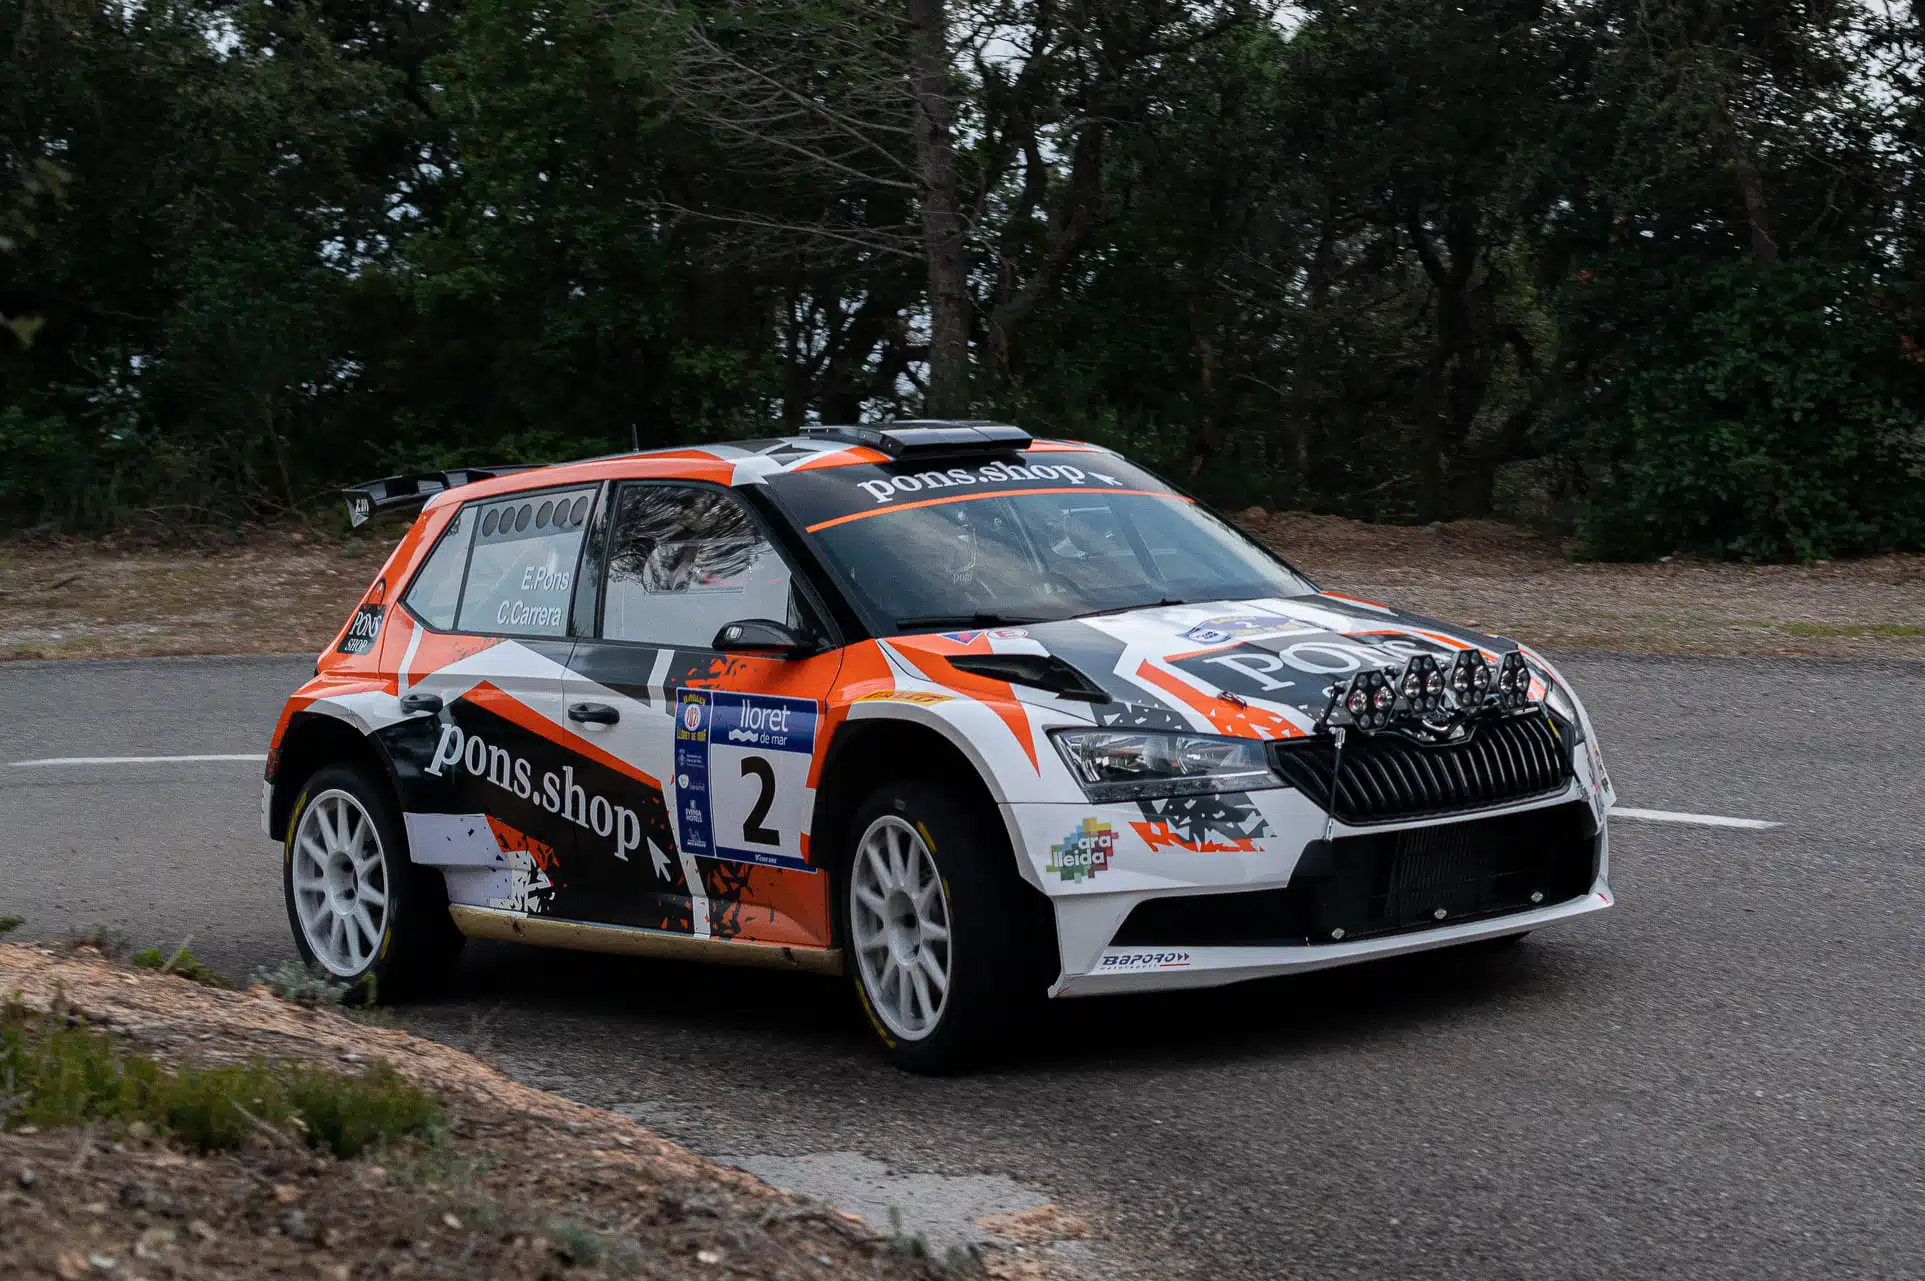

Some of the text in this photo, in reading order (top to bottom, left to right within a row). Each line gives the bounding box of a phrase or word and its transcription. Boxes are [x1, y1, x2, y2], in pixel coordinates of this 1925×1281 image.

[857, 461, 1086, 504] pons.shop
[521, 565, 570, 592] E.Pons
[349, 611, 382, 638] PONS
[497, 600, 562, 627] C.Carrera
[344, 638, 368, 653] SHOP
[739, 699, 791, 732] lloret
[759, 732, 788, 746] de mar
[424, 723, 641, 862] pons.shop
[740, 755, 781, 847] 2
[1078, 834, 1112, 849] ara
[1053, 850, 1105, 867] lleida
